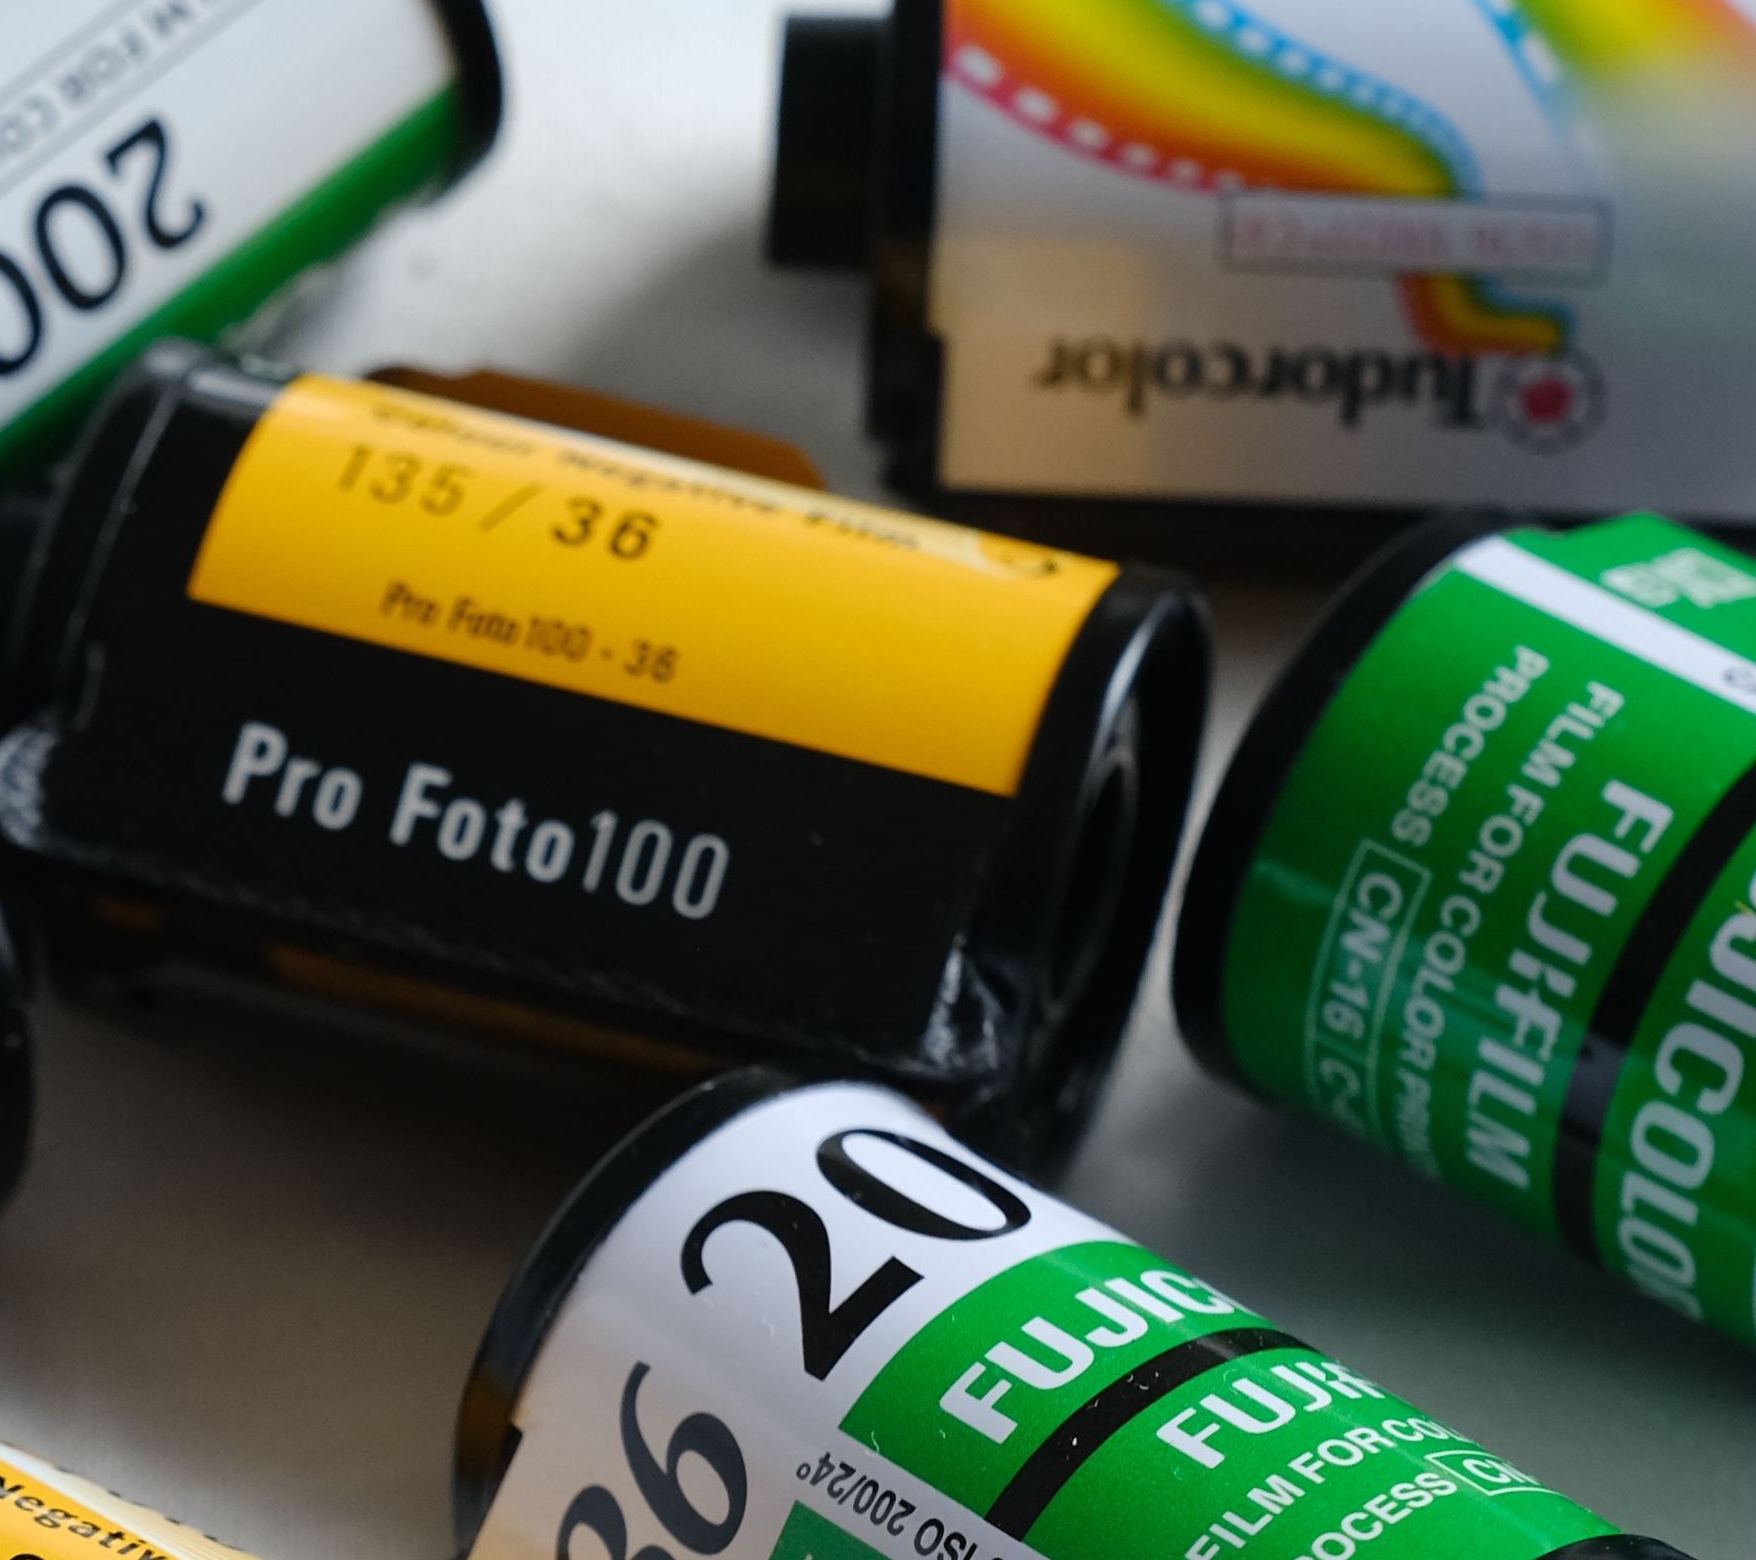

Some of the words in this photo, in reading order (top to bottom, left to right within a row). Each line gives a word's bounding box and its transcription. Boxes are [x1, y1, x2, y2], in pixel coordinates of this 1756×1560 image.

[58, 31, 147, 105] FOR
[1044, 342, 1491, 435] Tudorcolor
[334, 446, 465, 523] 135
[550, 499, 659, 563] 36
[380, 582, 439, 627] Pro
[447, 598, 591, 662] Foto100
[624, 642, 677, 684] 36
[1393, 645, 1550, 844] PROCESS
[1523, 681, 1624, 786] FILM
[224, 723, 361, 829] Pro
[390, 764, 728, 918] Foto100
[1460, 784, 1544, 892] FOR
[1321, 875, 1400, 1040] CN-16
[1402, 896, 1480, 1069] COLOR
[1469, 780, 1673, 1185] FUJIFILM
[1617, 872, 1756, 1322] JICOLO
[676, 1124, 1035, 1386] 20
[940, 1270, 1234, 1443] FUJIC
[1294, 1422, 1396, 1483] FOR
[1381, 1416, 1474, 1443] COL
